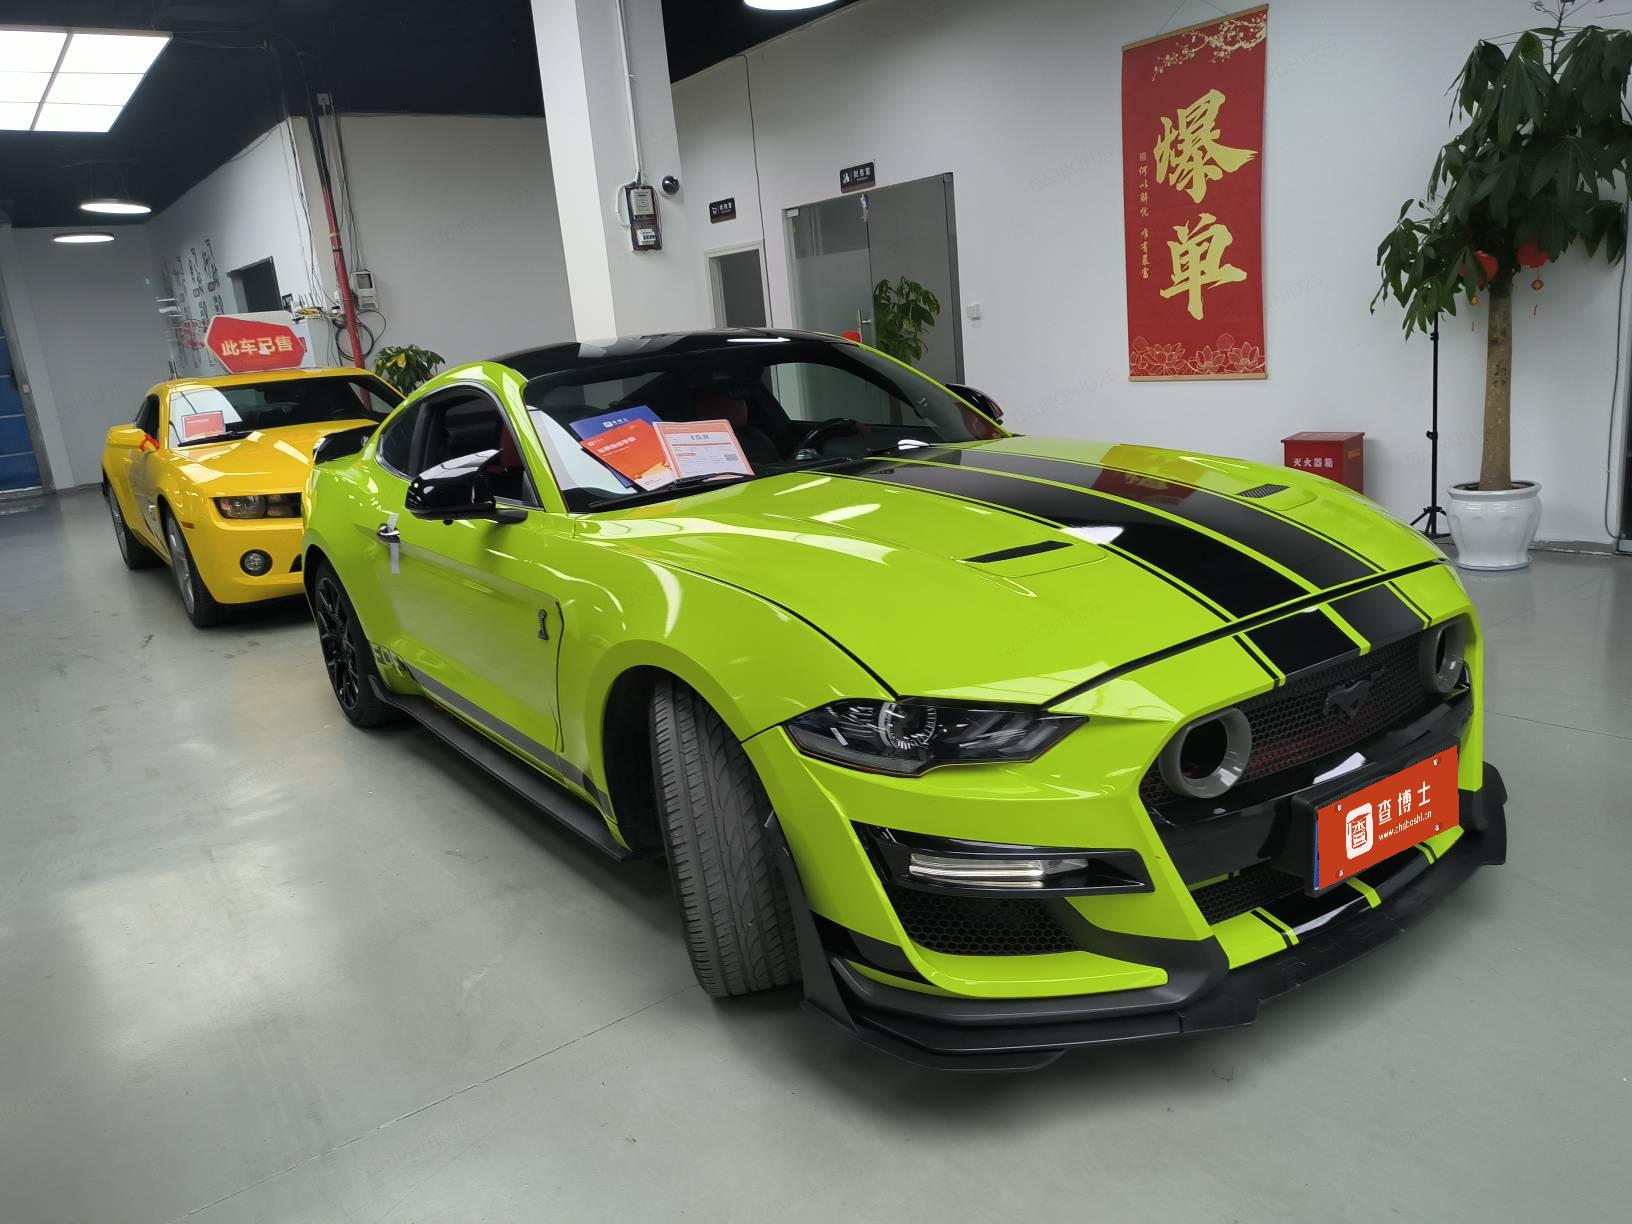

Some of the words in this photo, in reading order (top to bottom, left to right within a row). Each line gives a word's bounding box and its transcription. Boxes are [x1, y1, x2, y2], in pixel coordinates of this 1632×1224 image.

[1153, 88, 1259, 321] 爆单
[1293, 457, 1333, 468] 灭火器箱
